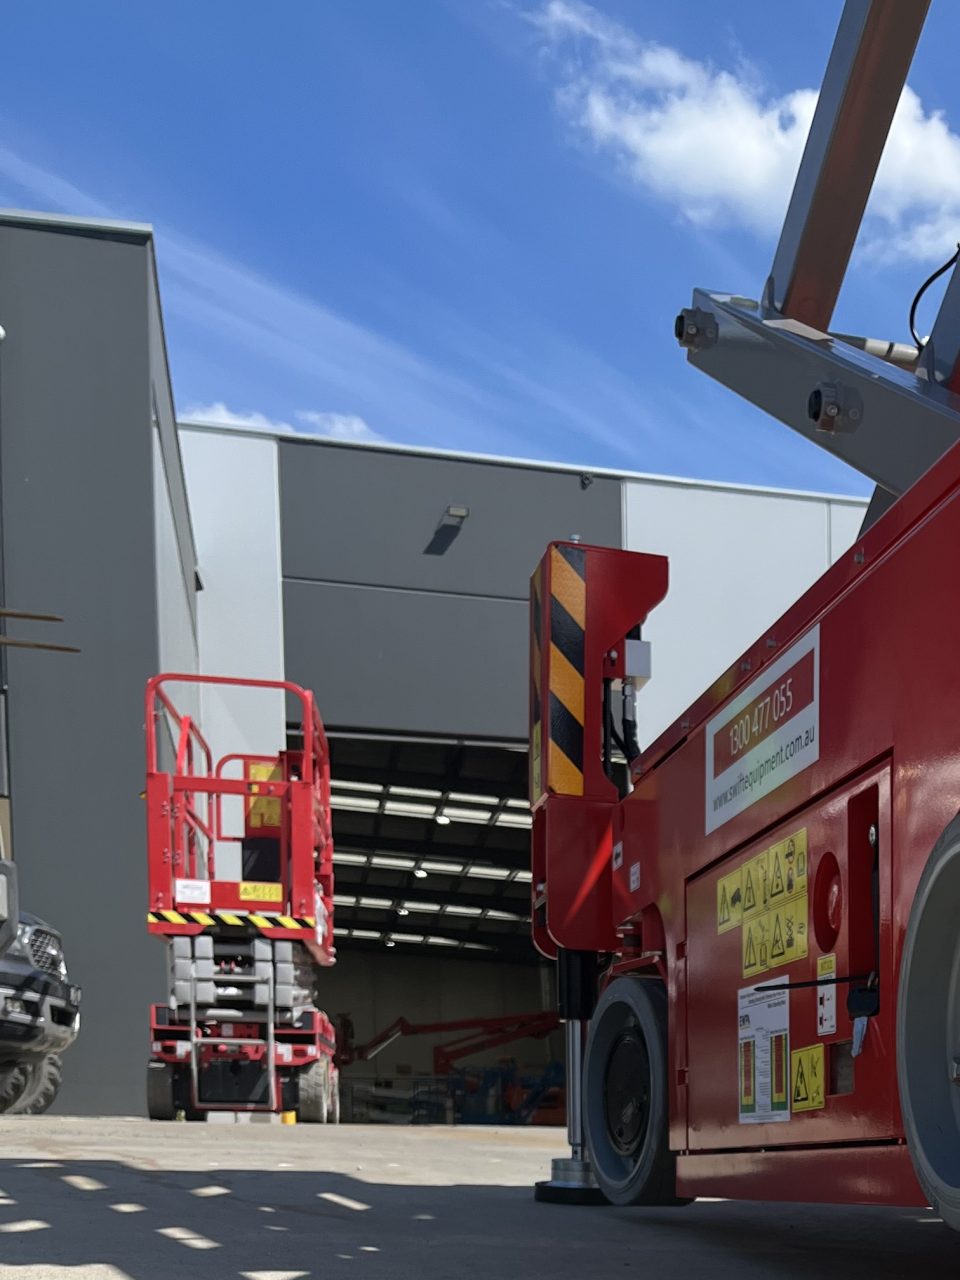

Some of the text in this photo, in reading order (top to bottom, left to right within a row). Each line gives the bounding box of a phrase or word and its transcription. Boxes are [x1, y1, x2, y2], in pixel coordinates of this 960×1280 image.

[729, 678, 793, 756] 1300 477 055
[713, 725, 815, 812] www.swiftequipment.com.au
